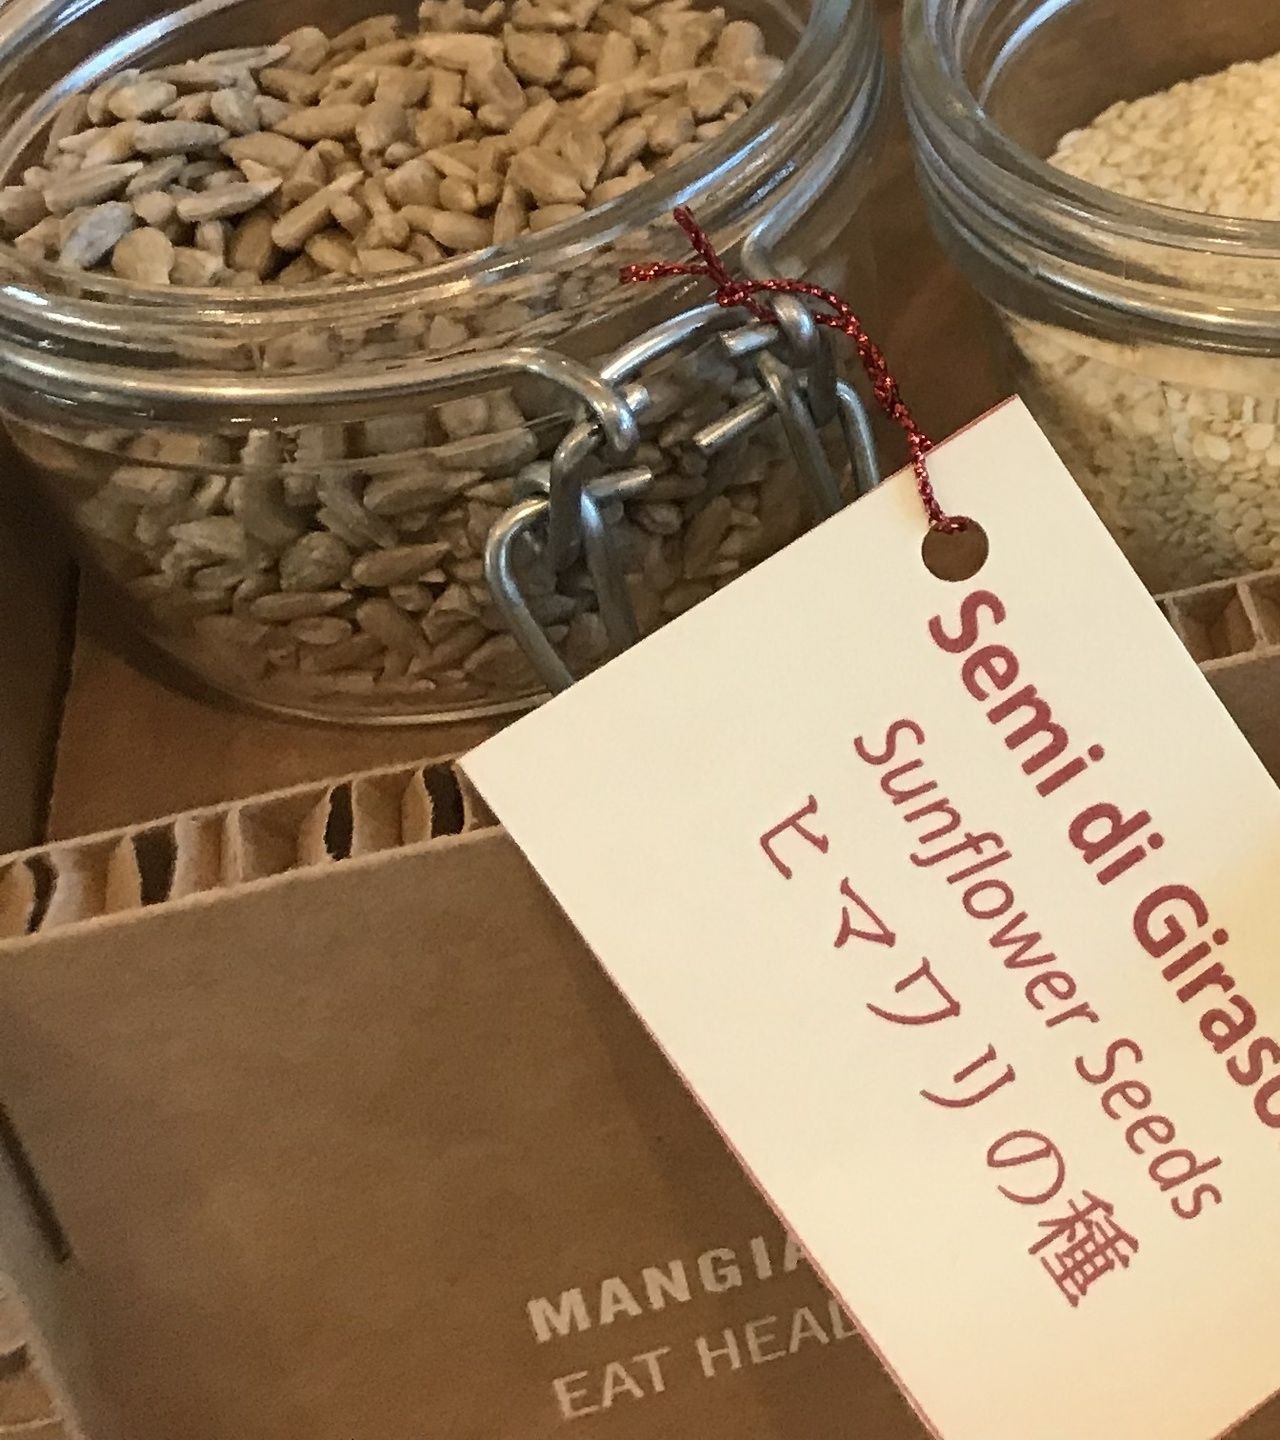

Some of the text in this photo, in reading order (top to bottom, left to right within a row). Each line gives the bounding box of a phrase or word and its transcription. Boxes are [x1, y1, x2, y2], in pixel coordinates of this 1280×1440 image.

[926, 588, 1106, 798] Semi
[1067, 801, 1166, 886] di
[758, 794, 1141, 1309] ヒマワリの種
[853, 717, 1223, 1221] Sunflower Seeds
[552, 1346, 672, 1420] EAT
